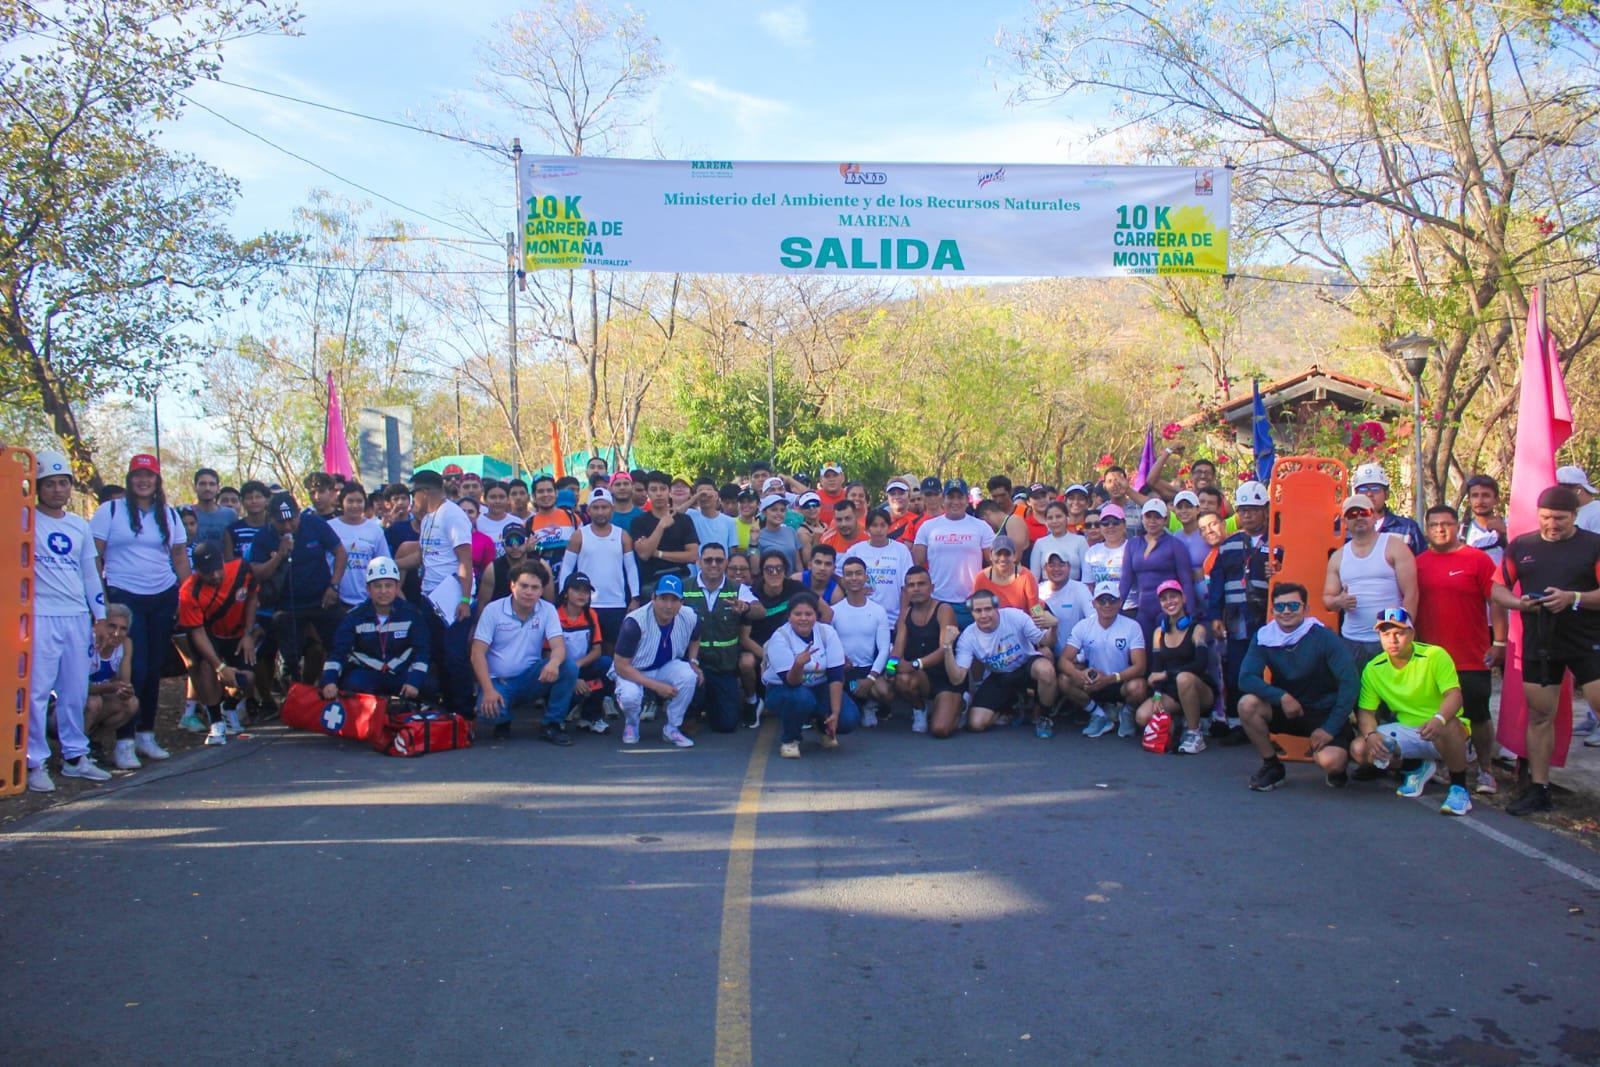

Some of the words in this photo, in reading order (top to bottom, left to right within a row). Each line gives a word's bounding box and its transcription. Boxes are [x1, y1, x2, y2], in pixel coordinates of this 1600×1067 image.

[845, 172, 887, 184] IND
[526, 195, 557, 219] 10
[565, 195, 582, 219] K
[664, 192, 747, 206] Ministerio
[752, 193, 775, 206] del
[781, 193, 859, 207] Ambiente
[863, 197, 872, 210] y
[876, 194, 895, 207] de
[900, 194, 922, 208] los
[927, 196, 1000, 209] Recursos
[1004, 197, 1080, 211] Naturales
[839, 214, 911, 227] MARENA
[1116, 205, 1147, 229] 10
[1155, 206, 1171, 230] K
[525, 220, 598, 236] CARRERA
[602, 221, 623, 236] DE
[526, 239, 603, 256] MONTAÑA
[1114, 231, 1187, 247] CARRERA
[1192, 233, 1212, 246] DE
[579, 257, 587, 265] LA
[780, 237, 965, 271] SALIDA
[1113, 250, 1195, 267] MONTAÑA
